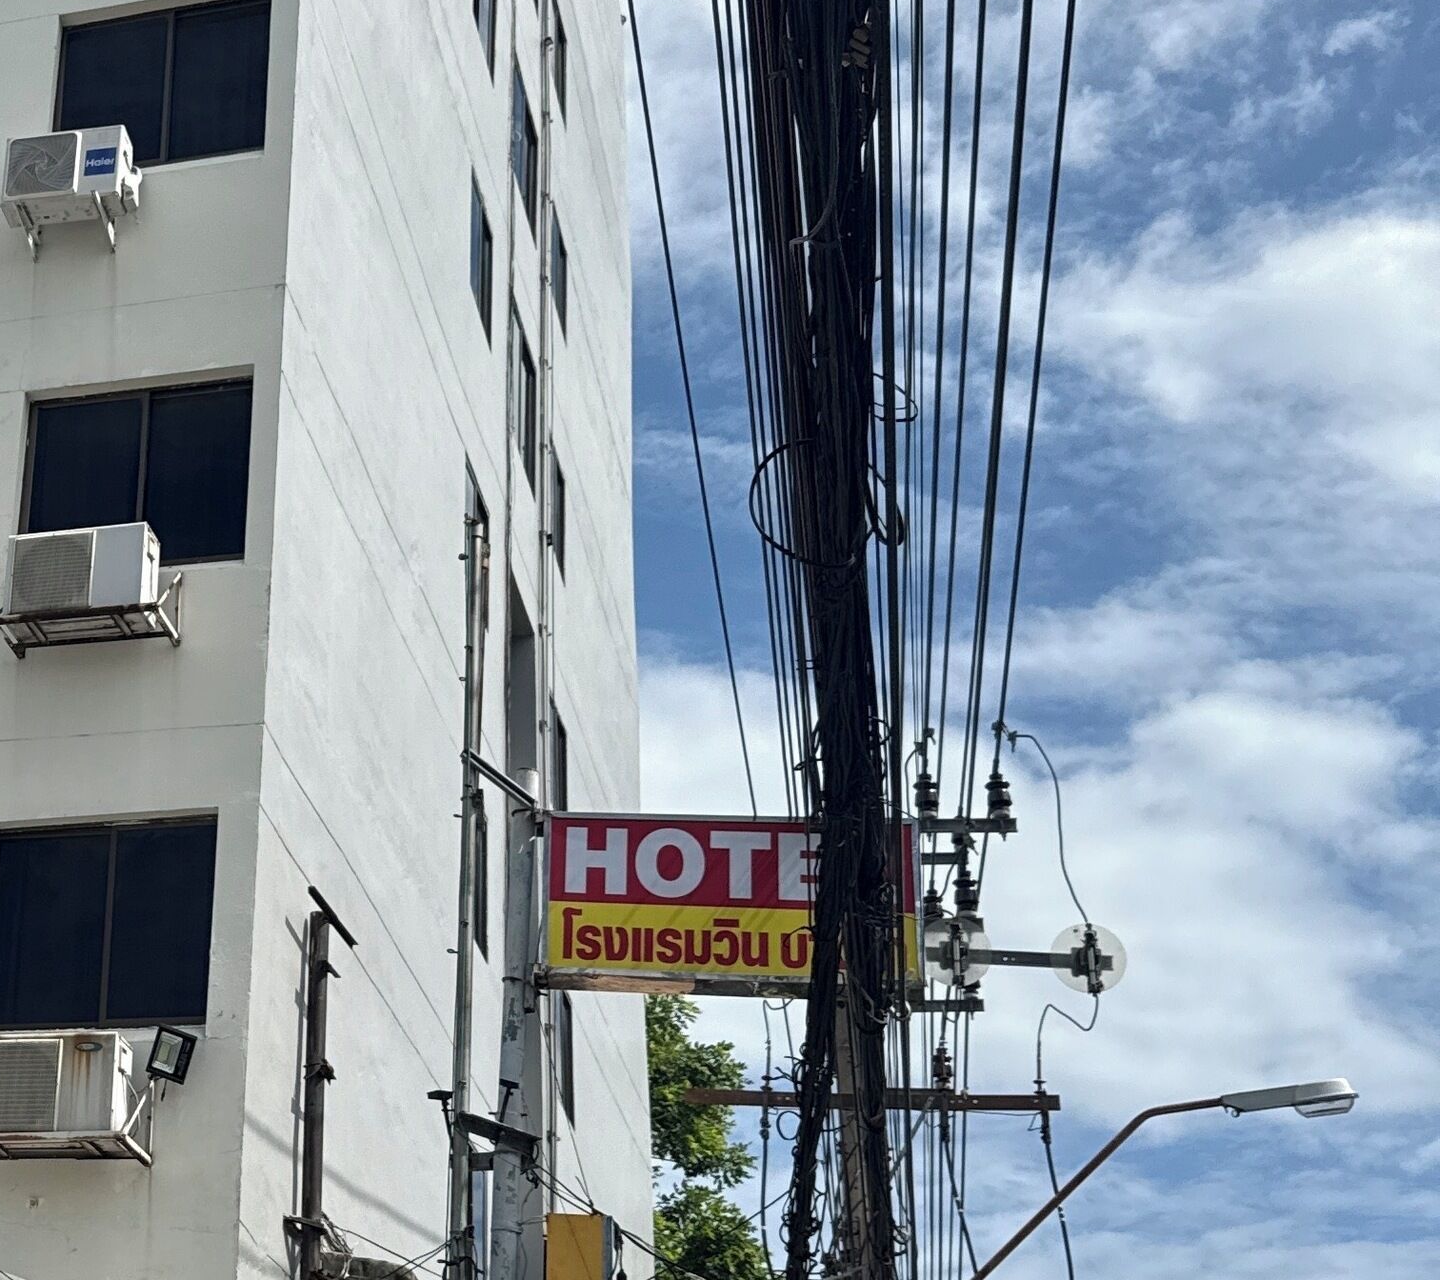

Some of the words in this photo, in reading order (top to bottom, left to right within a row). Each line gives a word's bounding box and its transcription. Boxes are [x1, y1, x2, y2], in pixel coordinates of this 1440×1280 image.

[564, 826, 822, 902] HOTE
[562, 907, 770, 968] โรงแรมวิน
